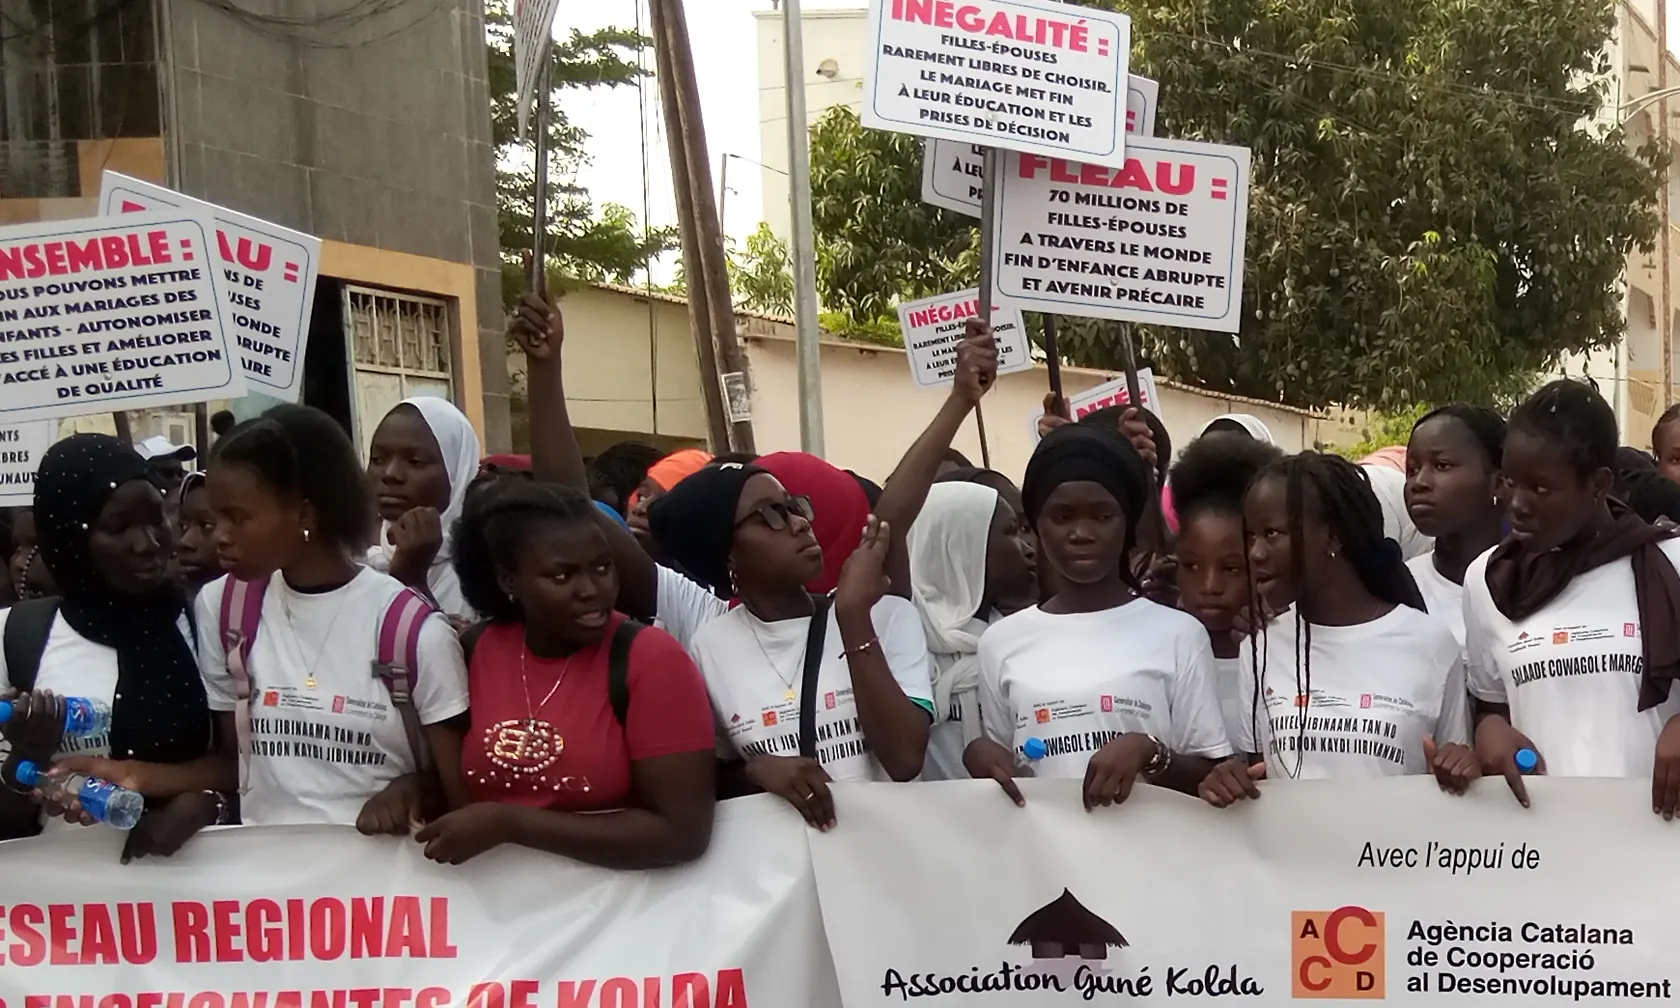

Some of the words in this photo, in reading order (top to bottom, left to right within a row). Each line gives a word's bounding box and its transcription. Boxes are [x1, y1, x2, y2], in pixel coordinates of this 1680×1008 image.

[942, 35, 1057, 64] FILLES-ÉPOUSES
[883, 44, 965, 66] RAREMENT
[969, 59, 1018, 76] LIBRES
[1022, 68, 1040, 80] DE
[1045, 72, 1111, 93] CHOISIR.
[920, 70, 936, 82] LE
[940, 73, 1012, 94] MARIAGE
[1016, 86, 1046, 100] MET
[1050, 92, 1073, 105] FIN
[1049, 190, 1070, 203] 70
[1075, 192, 1160, 212] MILLIONS
[1166, 202, 1188, 216] DE
[1048, 212, 1186, 238] FILLES-ÉPOUSES
[0, 231, 172, 280] NSEMBLE
[1020, 232, 1033, 245] A
[1038, 234, 1115, 253] TRAVERS
[1120, 243, 1138, 256] LE
[1144, 246, 1211, 264] MONDE
[0, 288, 29, 301] OUS
[33, 277, 126, 297] POUVONS
[131, 269, 200, 286] METTRE
[244, 277, 264, 291] DE
[24, 305, 60, 319] AUX
[64, 294, 160, 314] MARIAGES
[164, 290, 197, 303] DES
[78, 310, 212, 334] AUTONOMISER
[24, 345, 78, 360] FILLES
[82, 342, 100, 354] ET
[107, 330, 212, 352] AMÉLIORER
[72, 362, 108, 376] UNE
[112, 350, 221, 371] ÉDUCATION
[56, 386, 80, 398] DE
[85, 374, 163, 394] QUALITÉ
[1358, 842, 1418, 867] Avec
[1426, 842, 1504, 875] l'appui
[1512, 843, 1539, 869] de
[172, 896, 456, 962] REGIONAL
[1407, 920, 1512, 946] Agència
[1522, 922, 1633, 944] Catalana
[1408, 946, 1438, 966] de
[1447, 947, 1594, 973] Cooperació
[881, 962, 1066, 1001] Association
[1074, 965, 1152, 1000] Guné
[1166, 964, 1264, 996] Kolda
[1408, 972, 1428, 992] al
[1439, 973, 1670, 1001] Desenvolupament
